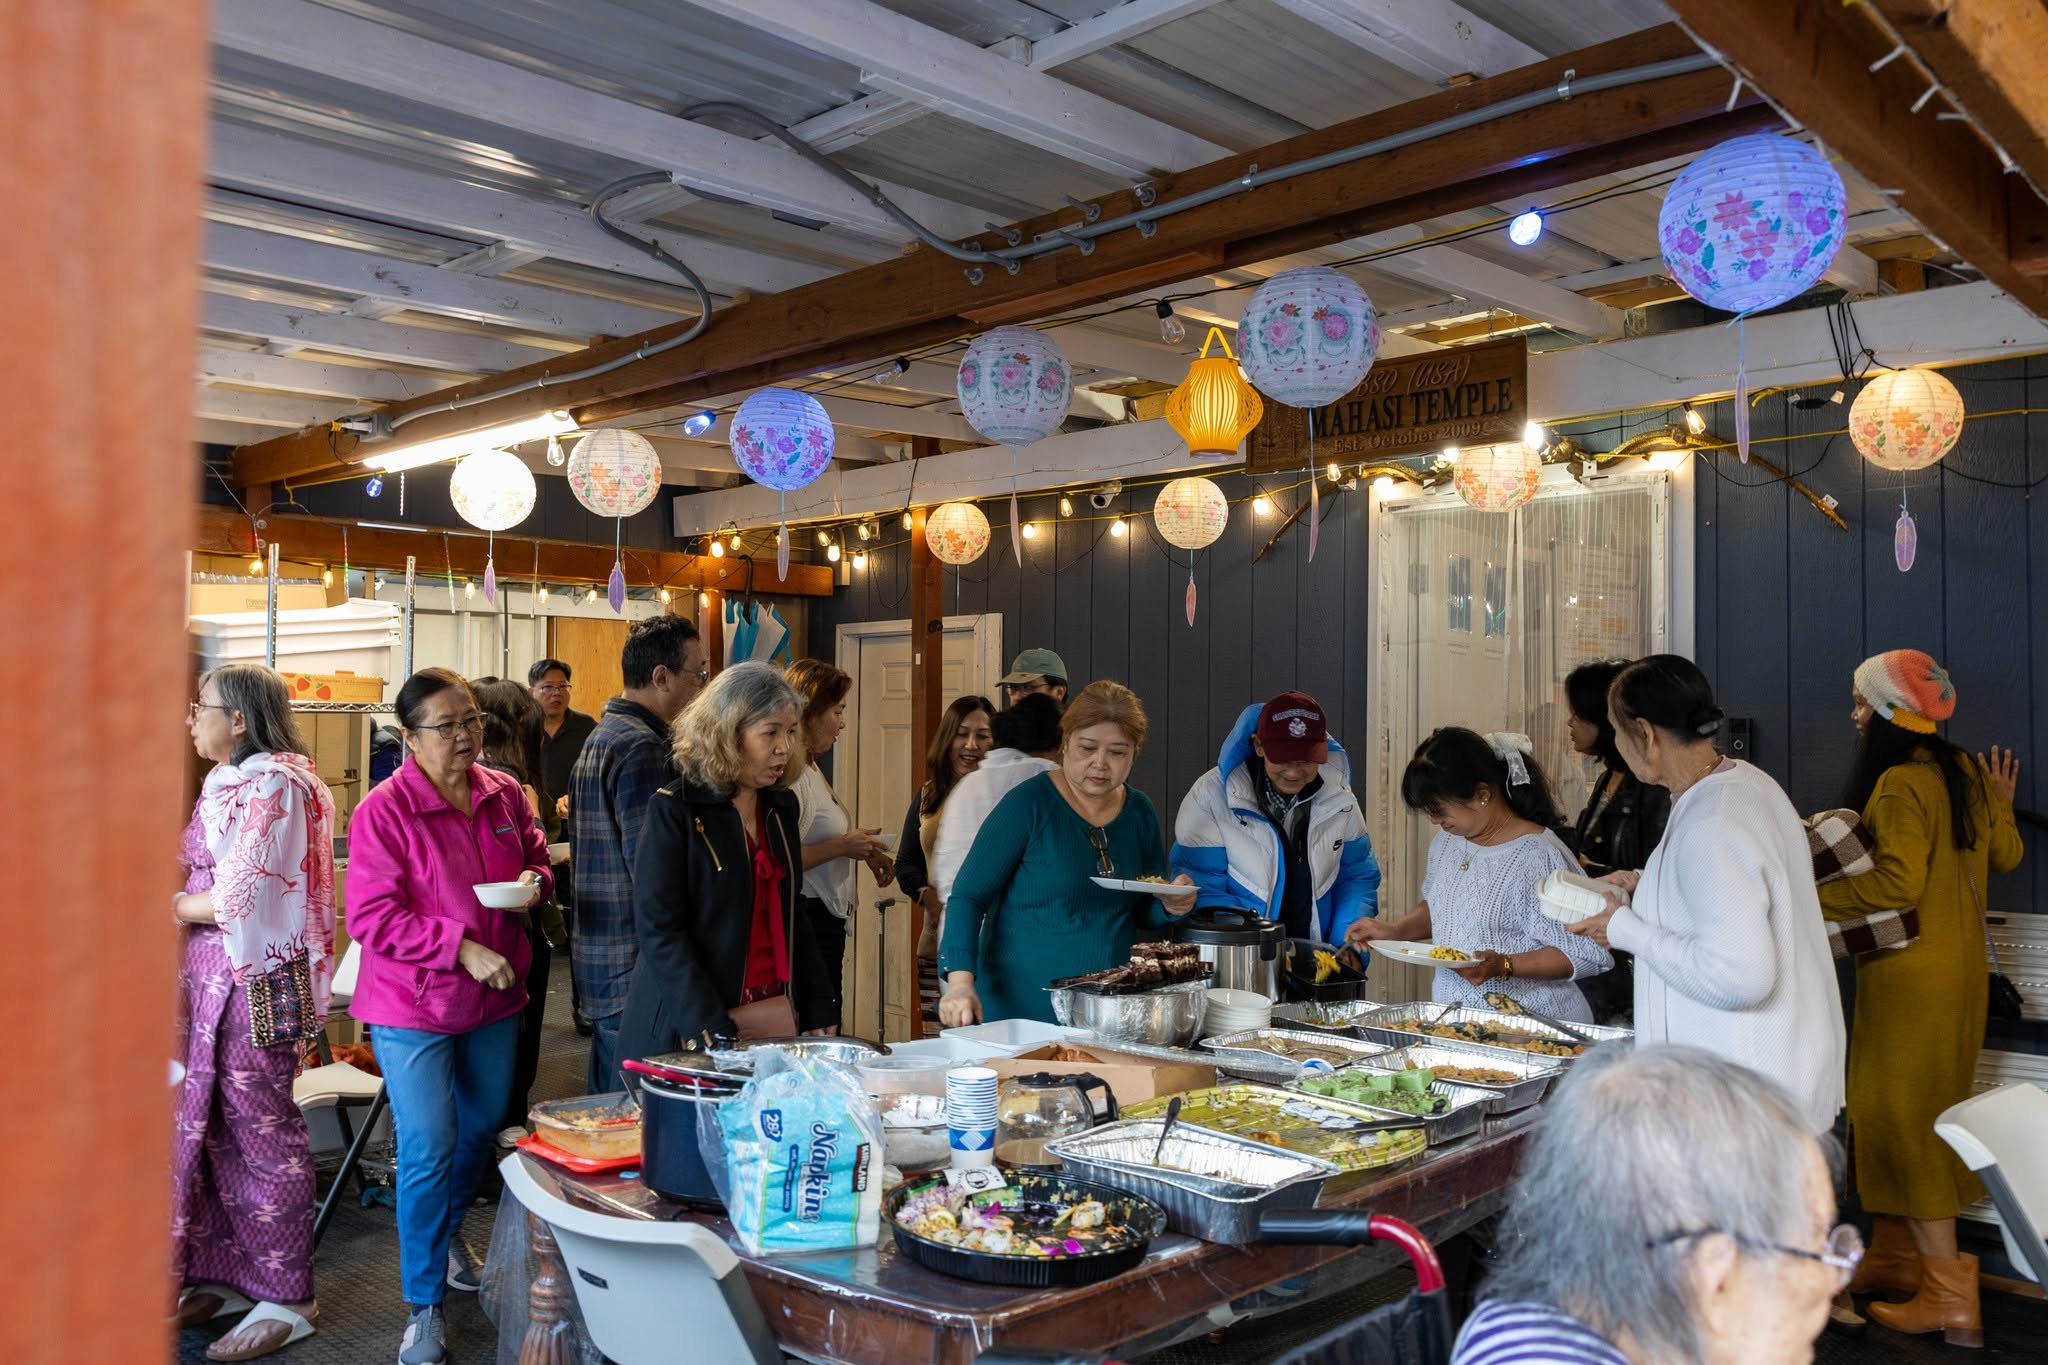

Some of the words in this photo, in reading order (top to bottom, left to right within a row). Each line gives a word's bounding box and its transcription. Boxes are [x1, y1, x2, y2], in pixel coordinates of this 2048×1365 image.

[1407, 352, 1471, 395] (USA)
[1309, 394, 1404, 438] MAHASI
[1409, 377, 1512, 426] TEMPLE
[1333, 439, 1365, 454] Est.
[1368, 429, 1437, 449] October
[1441, 421, 1481, 439] 2009
[802, 1121, 838, 1223] Napkins
[857, 1145, 870, 1191] KIRLAND
